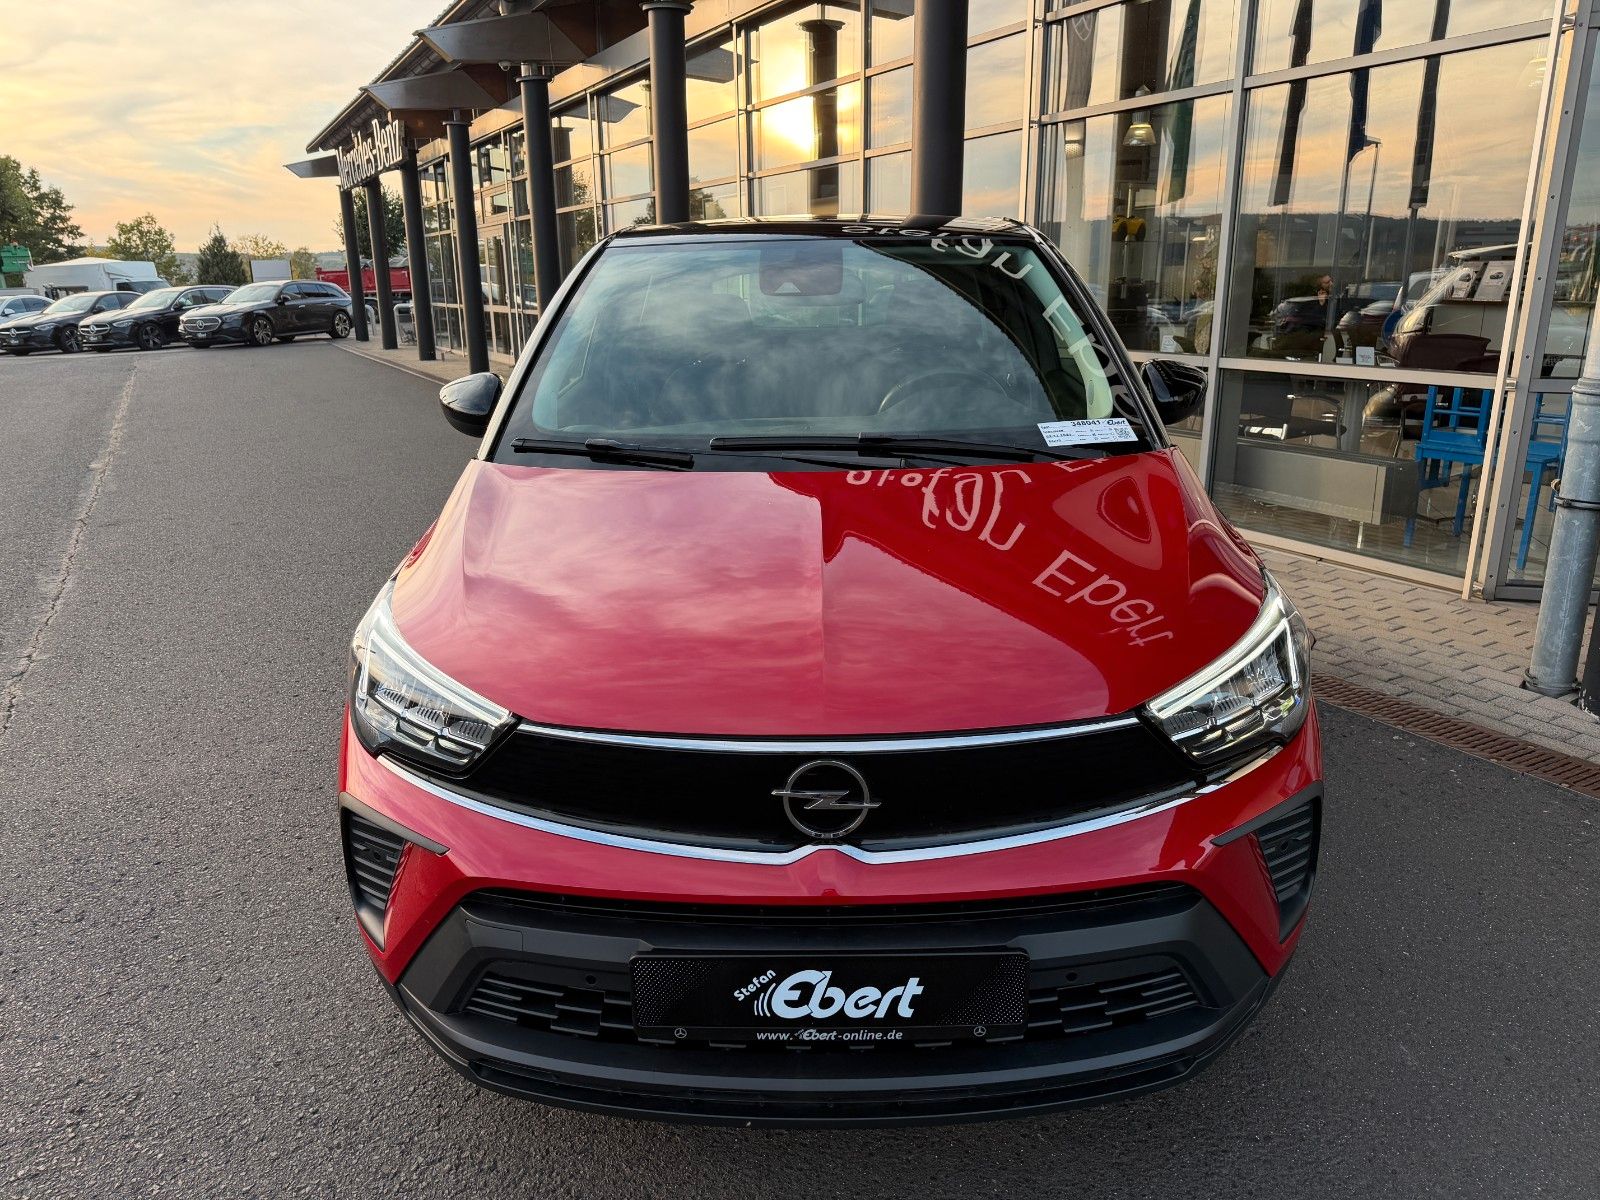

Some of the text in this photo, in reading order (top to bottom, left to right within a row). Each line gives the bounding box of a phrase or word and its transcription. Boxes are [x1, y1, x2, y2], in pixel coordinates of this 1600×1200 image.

[733, 969, 925, 1019] Stefan Ebert
[756, 1028, 903, 1041] www.Ebert-online.de
